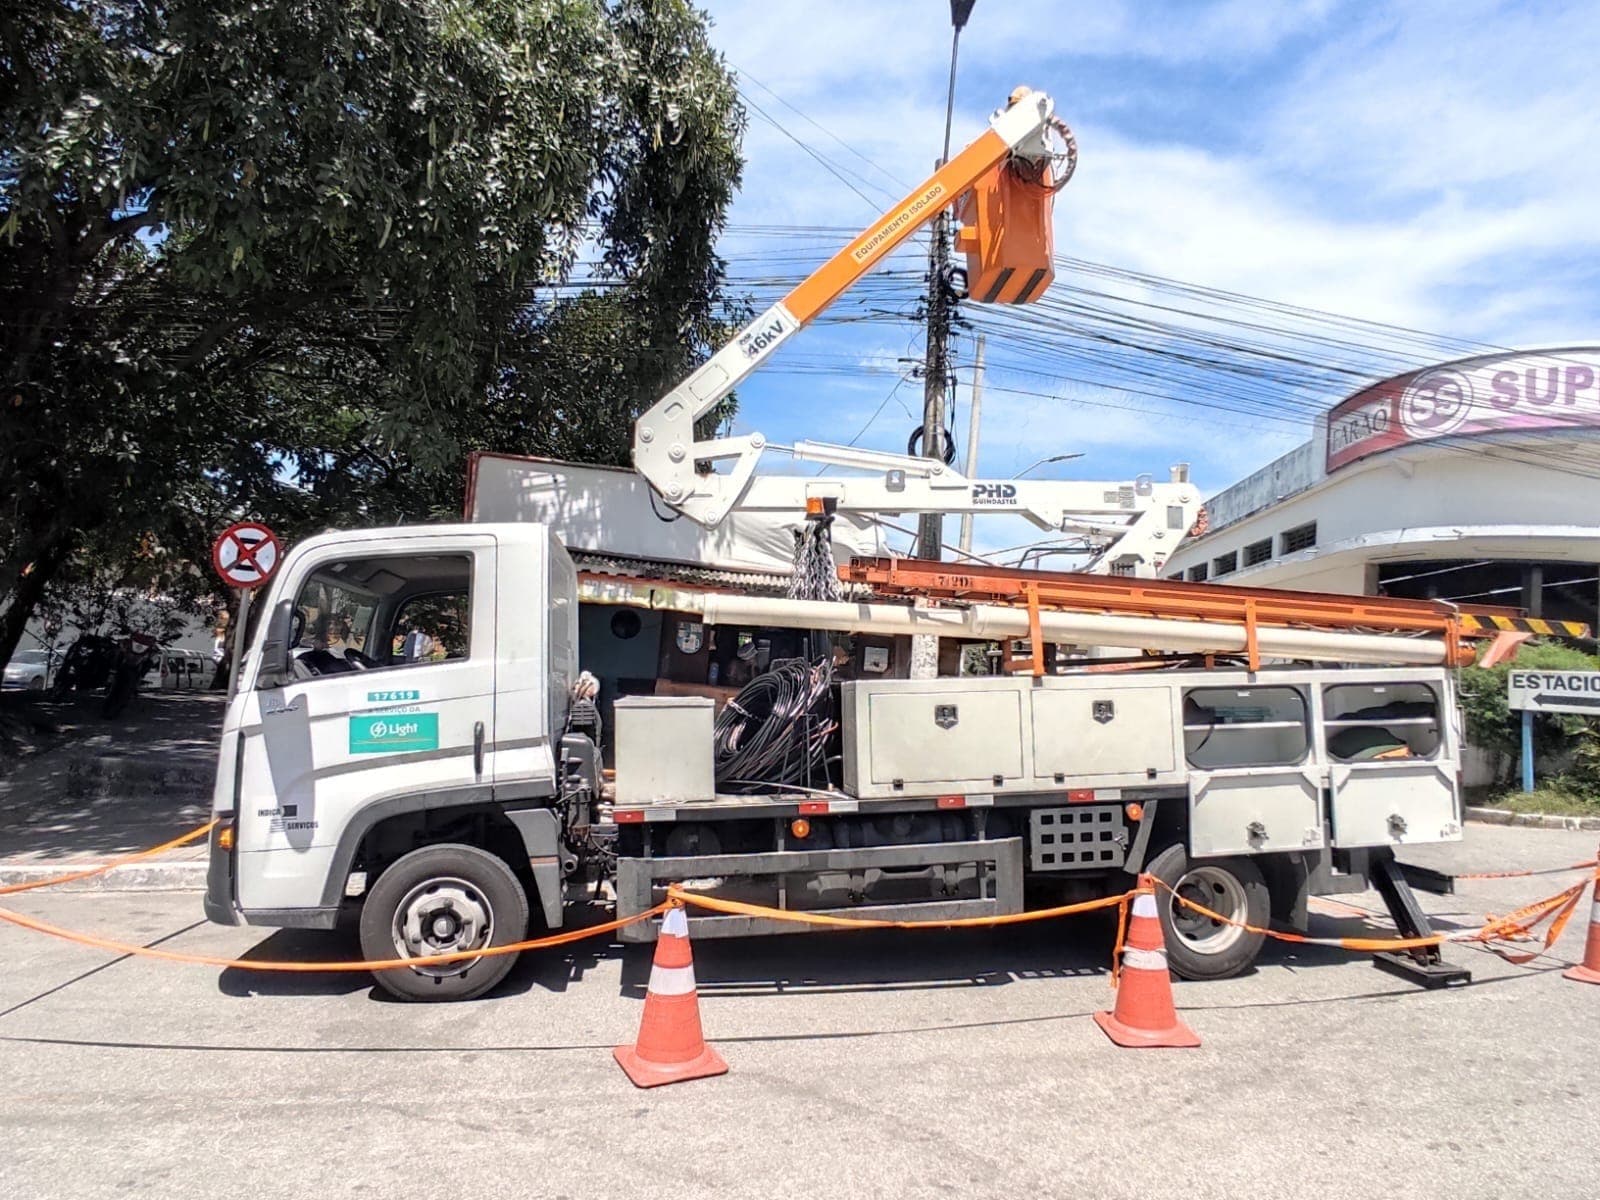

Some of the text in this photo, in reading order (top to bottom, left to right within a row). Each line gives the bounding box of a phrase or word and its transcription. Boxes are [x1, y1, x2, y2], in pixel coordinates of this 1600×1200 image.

[855, 186, 942, 259] EQUIPAMENTO ISOLADO
[748, 320, 783, 357] 46kV
[1490, 366, 1600, 410] SUP
[972, 484, 1016, 498] PHD
[1512, 674, 1600, 692] ESTACIO
[374, 692, 414, 700] 17619
[389, 723, 418, 736] Light
